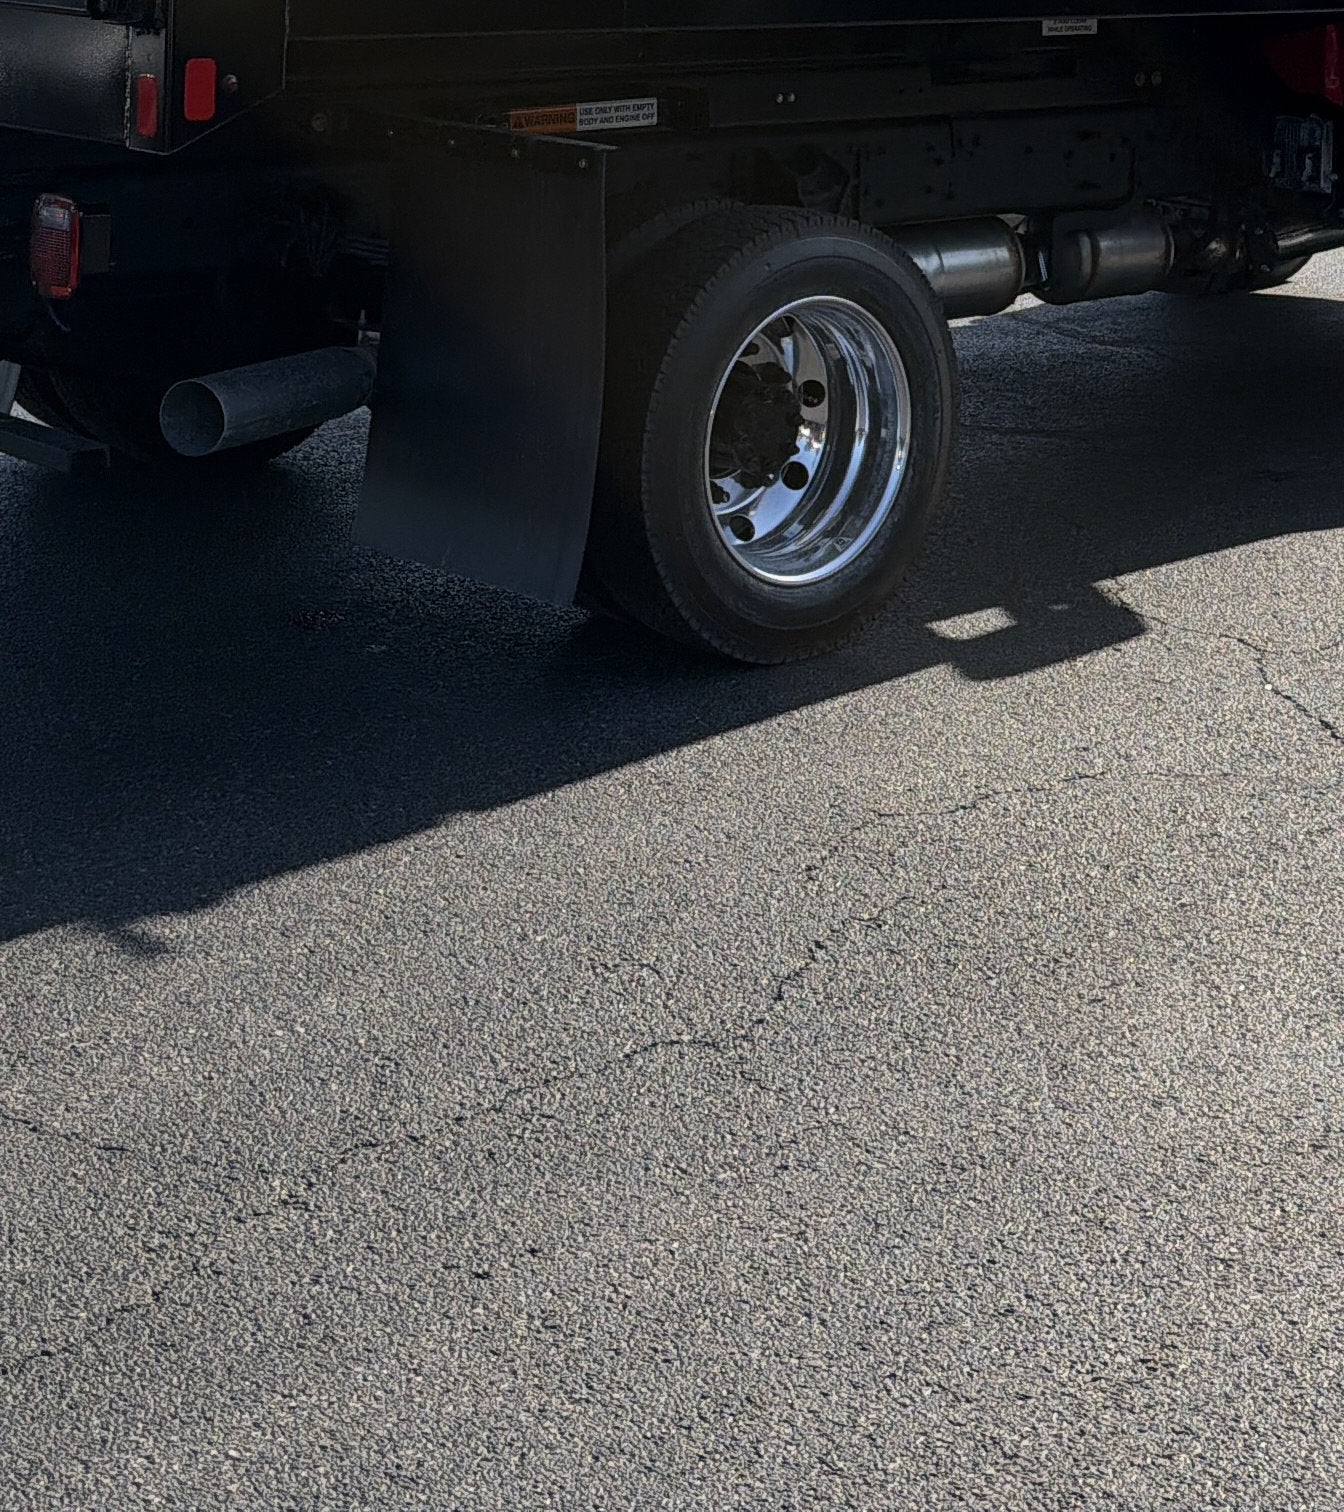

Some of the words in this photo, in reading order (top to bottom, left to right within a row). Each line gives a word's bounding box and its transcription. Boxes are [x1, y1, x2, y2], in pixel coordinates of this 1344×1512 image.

[579, 106, 593, 116] USE
[594, 105, 613, 115] ONLY
[613, 104, 631, 114] WITH
[632, 102, 655, 113] EMPTY
[525, 111, 576, 127] WARNING
[579, 116, 598, 127] BODY
[599, 115, 614, 125] AND
[615, 113, 641, 124] ENGINE
[641, 111, 656, 121] OFF
